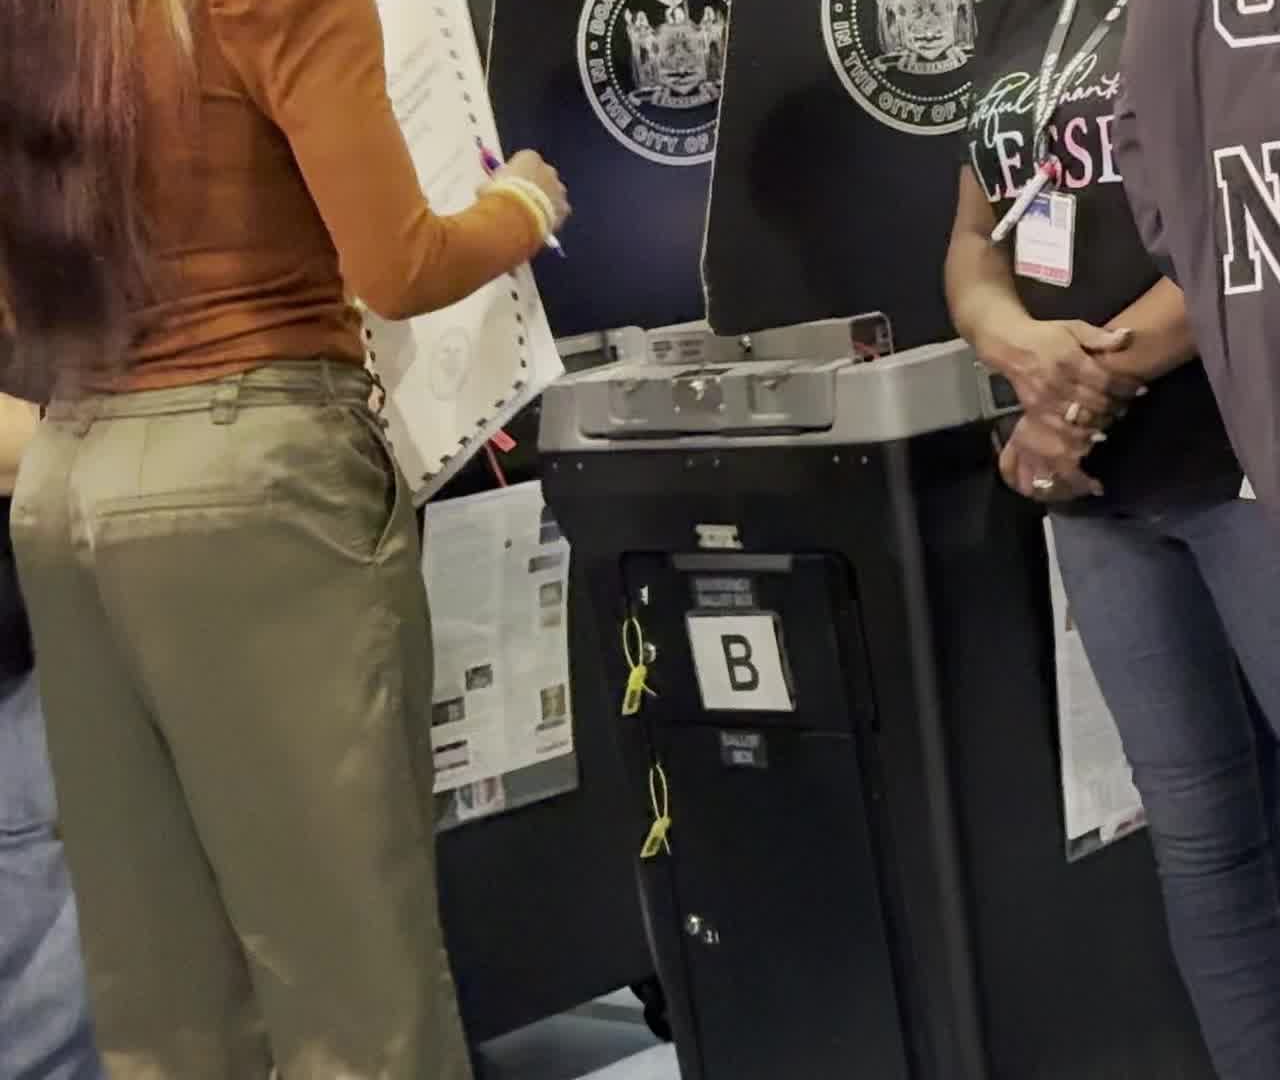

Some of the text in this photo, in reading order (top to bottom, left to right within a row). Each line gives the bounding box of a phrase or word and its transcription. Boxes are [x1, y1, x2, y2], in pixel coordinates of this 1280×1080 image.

[832, 21, 853, 49] IN
[843, 50, 879, 95] THE
[878, 91, 927, 123] CITY
[930, 101, 957, 123] OF
[599, 86, 633, 130] THE
[631, 123, 682, 154] CITY
[683, 133, 710, 155] OF
[720, 633, 760, 692] B
